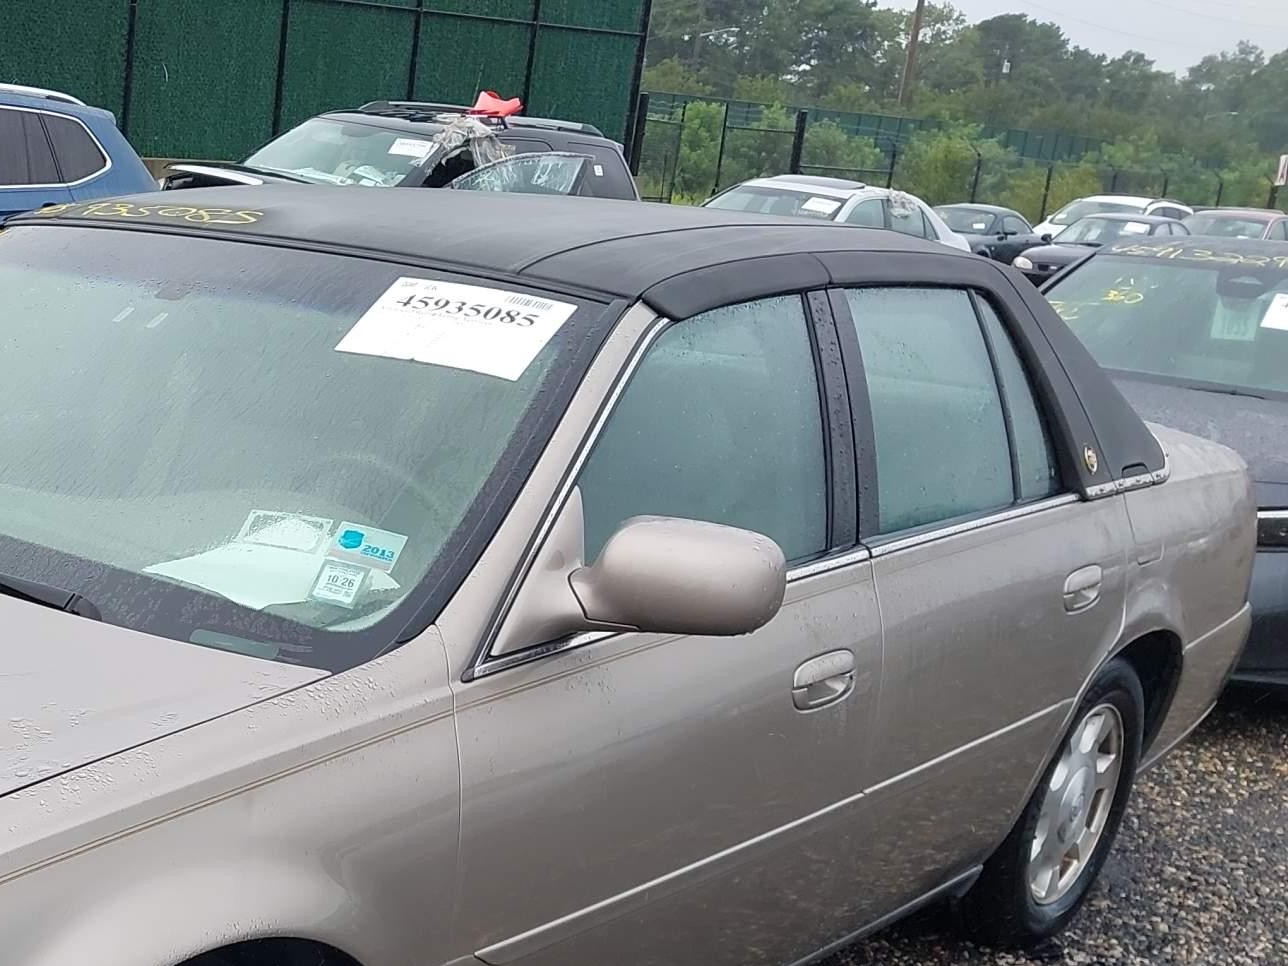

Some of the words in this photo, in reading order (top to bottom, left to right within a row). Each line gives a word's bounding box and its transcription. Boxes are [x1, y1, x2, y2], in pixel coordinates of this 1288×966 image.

[396, 294, 540, 328] 45935085
[361, 544, 395, 559] 2013
[341, 577, 355, 588] 26
